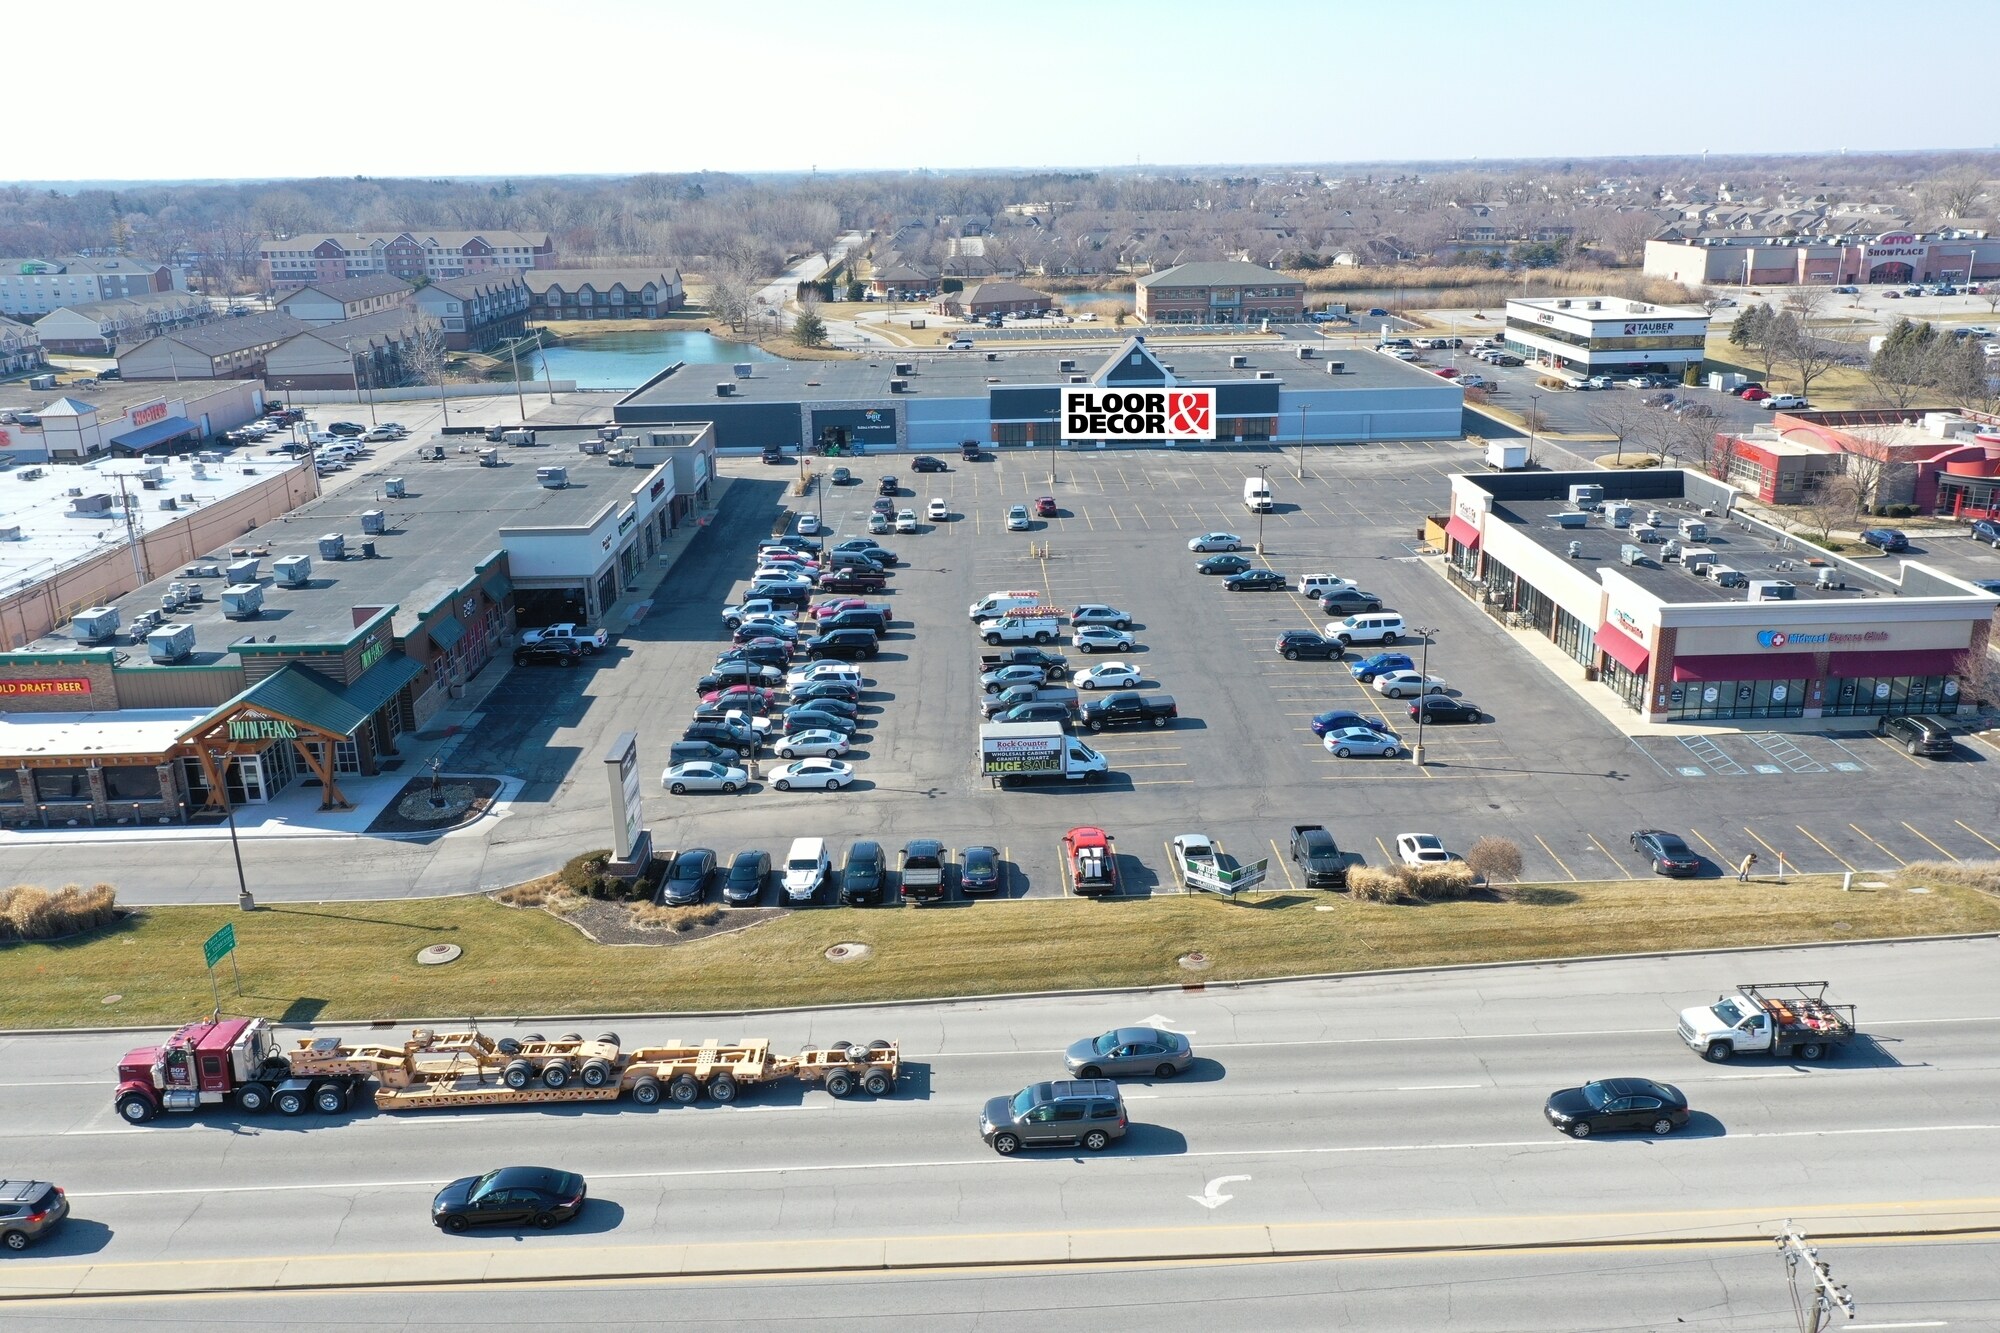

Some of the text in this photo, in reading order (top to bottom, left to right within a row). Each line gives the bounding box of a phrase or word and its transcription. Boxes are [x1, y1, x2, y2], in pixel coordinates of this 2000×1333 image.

[132, 403, 167, 426] HOOTERS
[1788, 634, 1828, 643] Midwest
[0, 682, 82, 693] LD DRAFT BEER
[229, 720, 297, 739] TWIN PEAKS
[985, 759, 1059, 772] HUGE SALE
